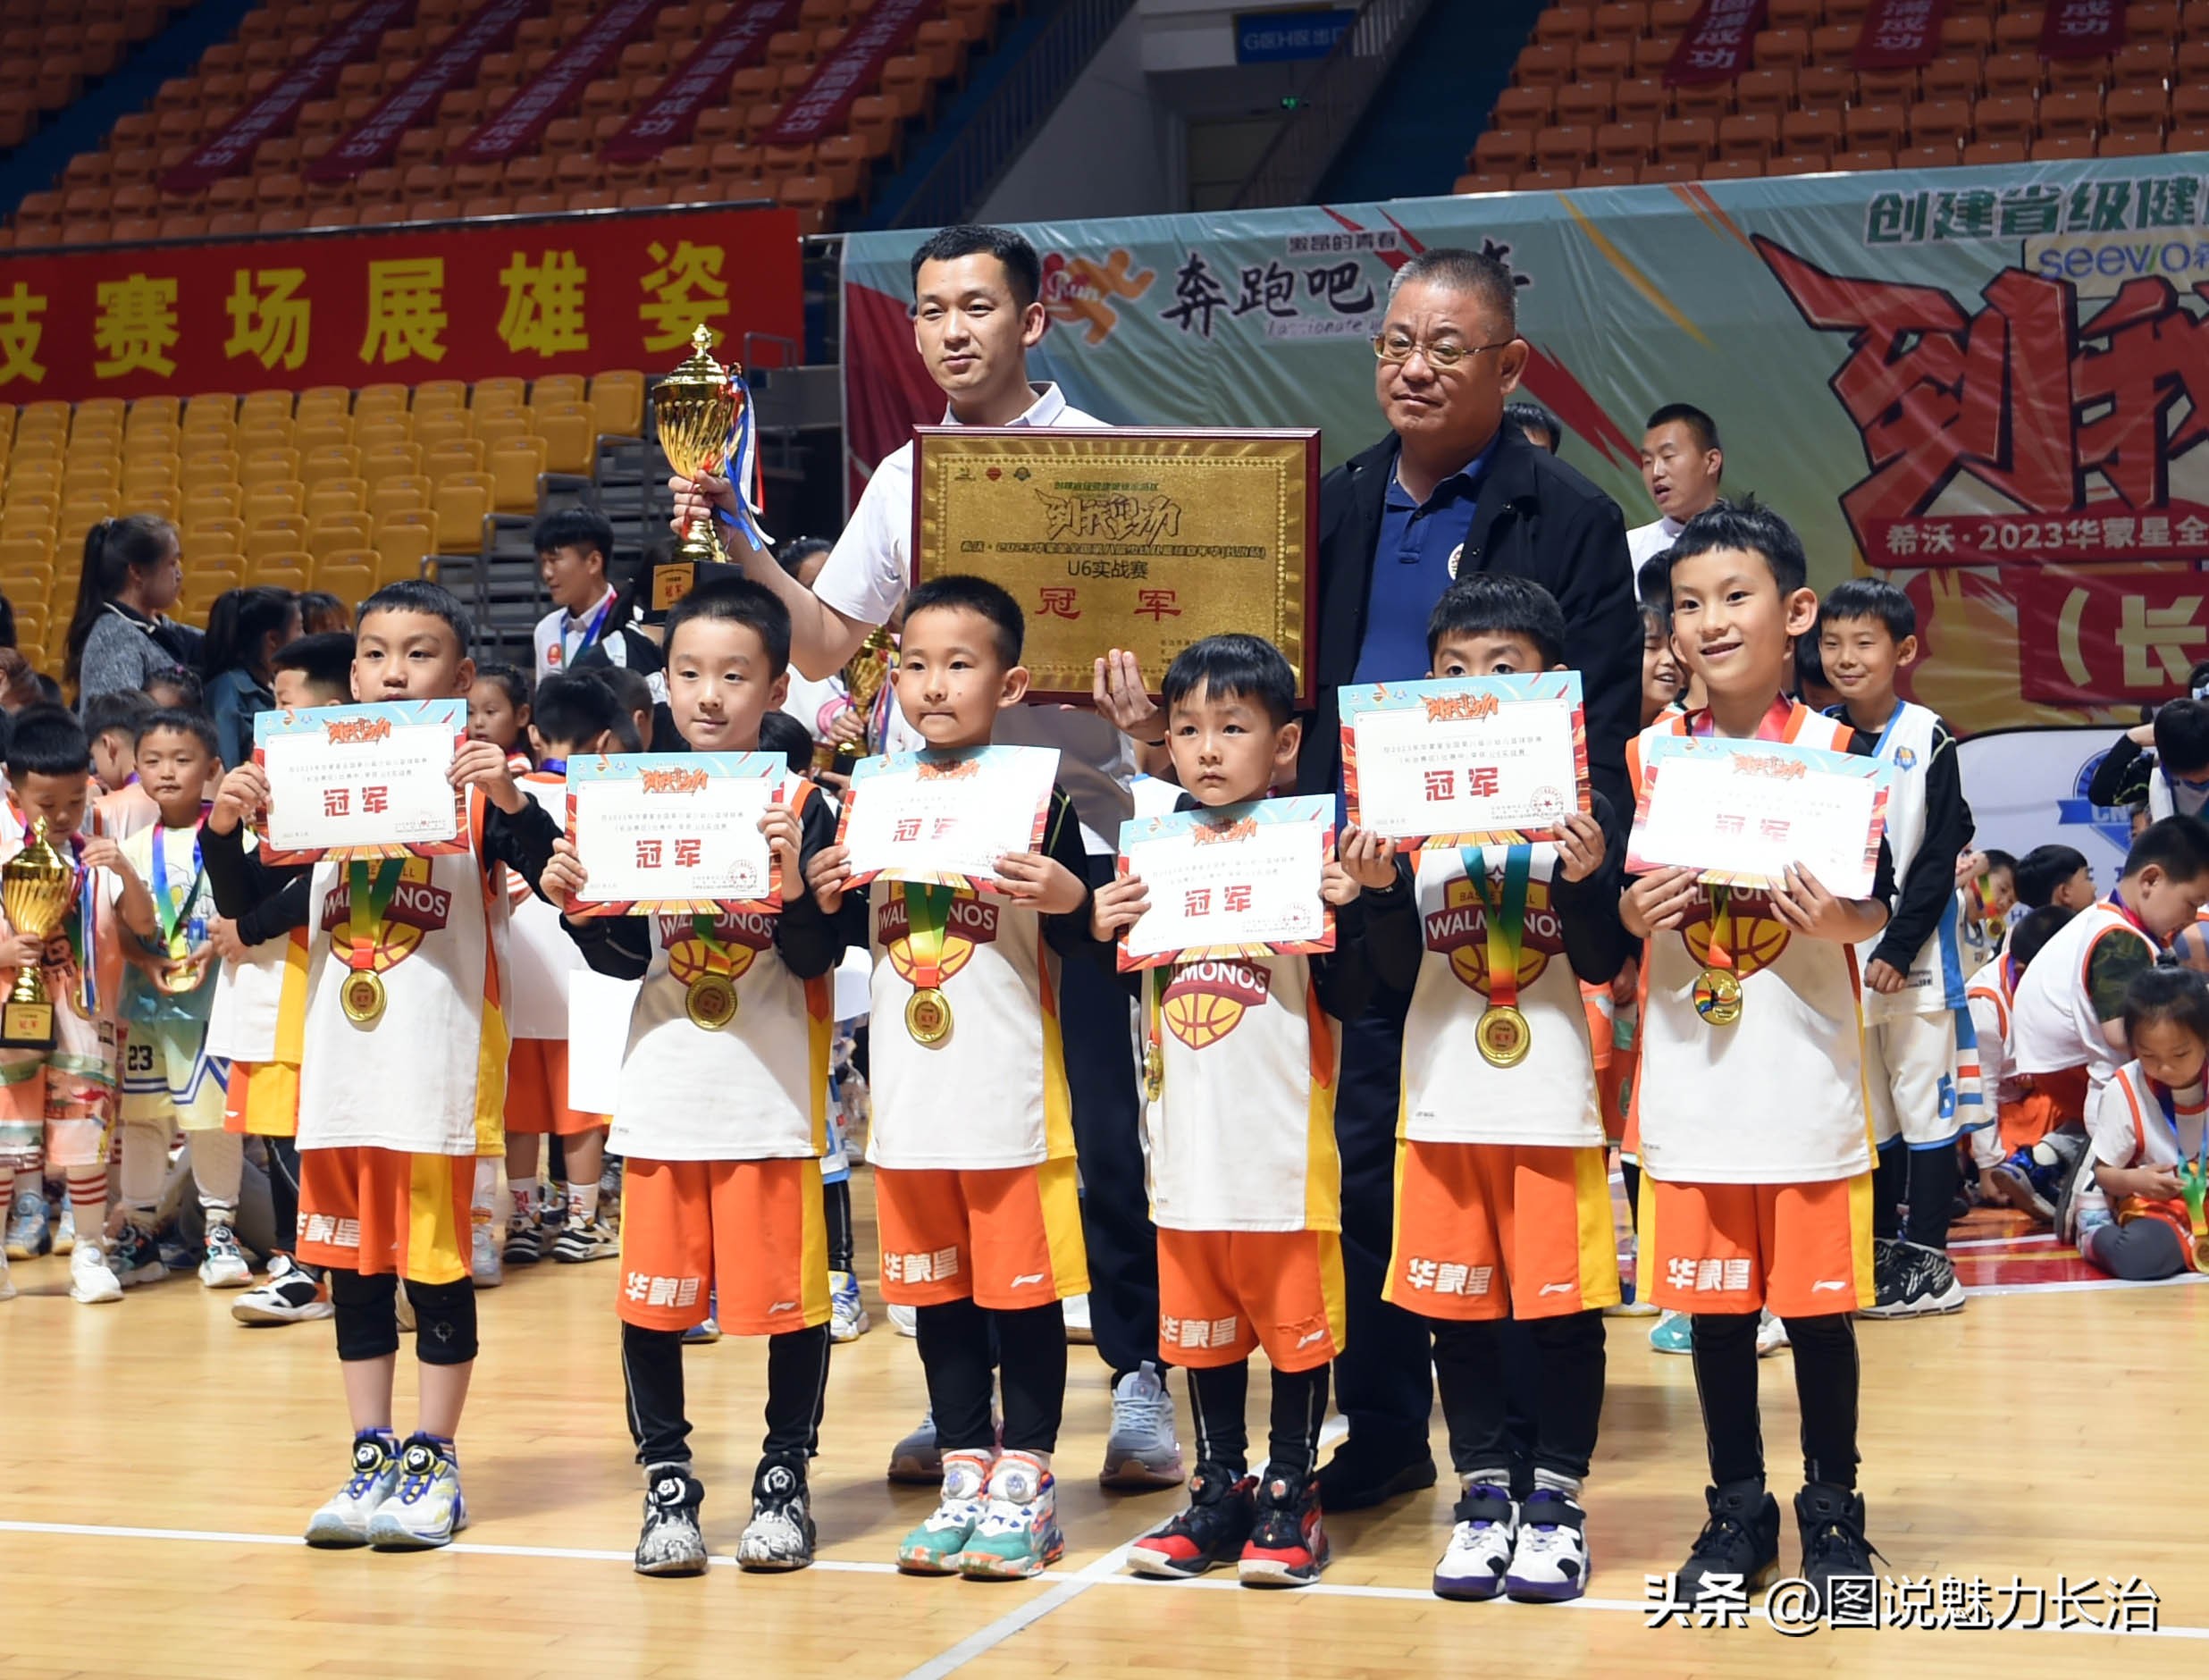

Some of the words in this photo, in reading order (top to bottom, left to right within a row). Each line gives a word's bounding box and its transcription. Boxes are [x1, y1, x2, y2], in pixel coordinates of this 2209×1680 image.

[1866, 175, 2209, 245] 创建省级健
[1068, 559, 1149, 579] U6实战赛
[323, 785, 389, 817] 冠军
[1424, 767, 1500, 802] 冠军
[636, 839, 701, 869] 冠军
[878, 904, 995, 931] WALNOS
[1185, 885, 1252, 917] 冠军
[128, 1045, 154, 1071] 23
[884, 1246, 958, 1284] 华蒙星
[1407, 1257, 1493, 1295] 华蒙星
[1667, 1256, 1752, 1292] 华蒙星
[625, 1271, 700, 1307] 华蒙星
[1161, 1314, 1237, 1348] 华蒙星
